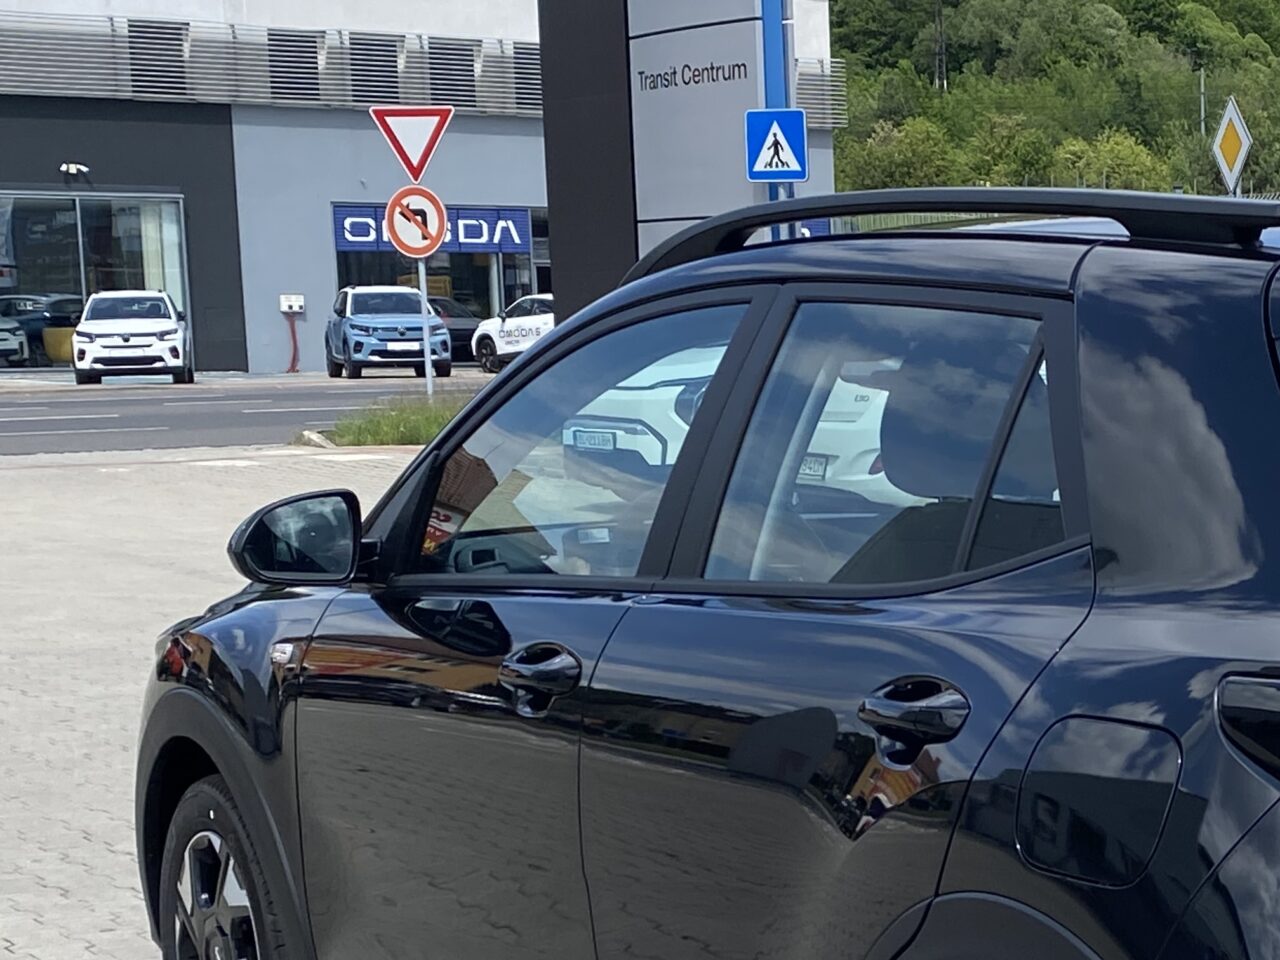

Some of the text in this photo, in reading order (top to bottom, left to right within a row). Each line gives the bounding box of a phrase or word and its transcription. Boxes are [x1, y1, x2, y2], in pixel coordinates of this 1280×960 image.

[638, 62, 748, 91] Transit Centrum
[343, 217, 521, 244] ODA
